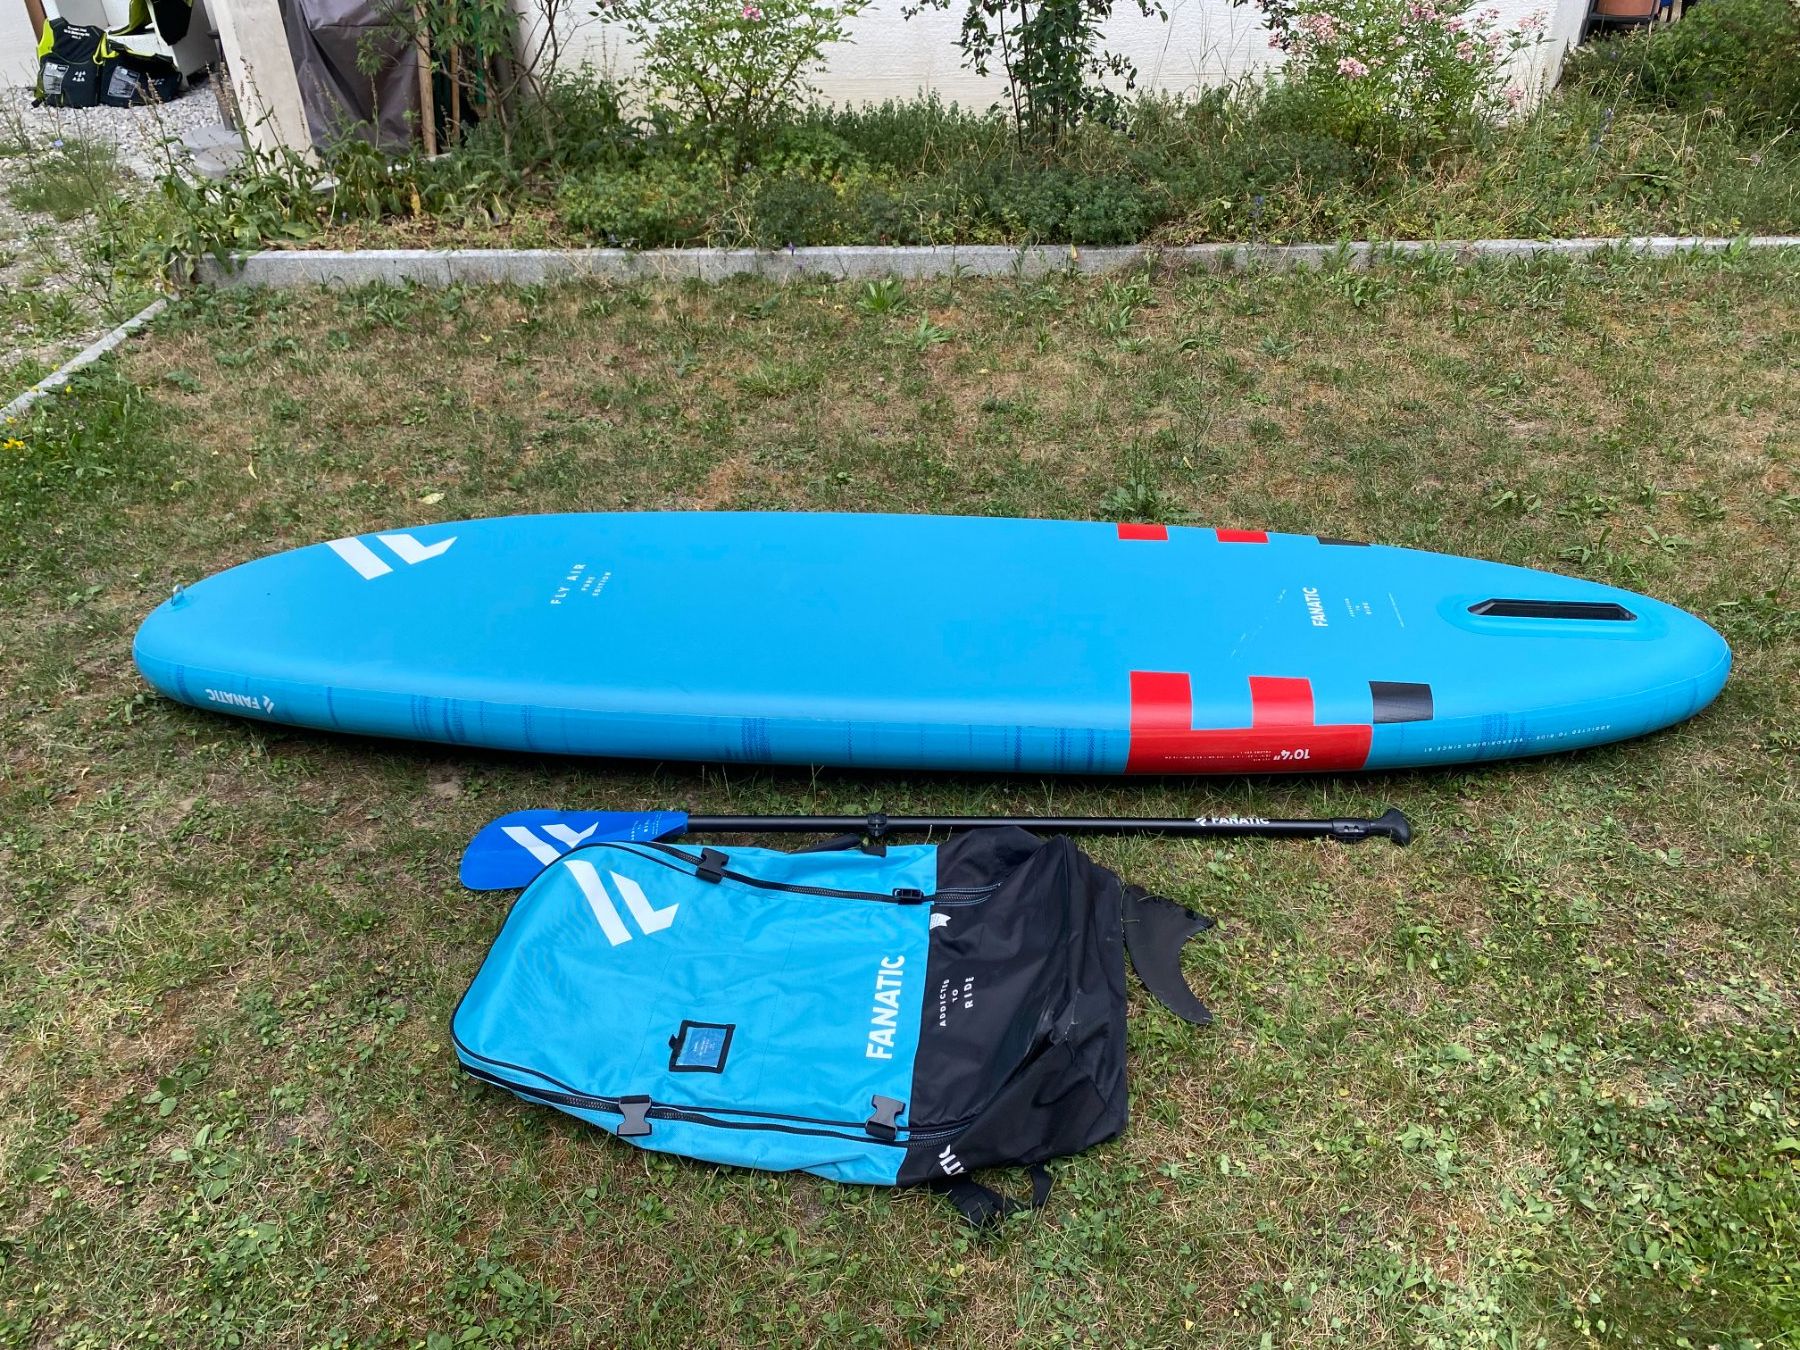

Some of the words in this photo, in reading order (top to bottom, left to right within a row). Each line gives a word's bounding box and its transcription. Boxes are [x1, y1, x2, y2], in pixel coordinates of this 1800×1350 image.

[550, 586, 570, 604] FLY
[566, 564, 586, 581] AIR
[1302, 586, 1328, 627] FANATIC
[205, 688, 261, 709] FANATIC
[1211, 817, 1270, 825] FANATIC
[865, 955, 905, 1060] FANATIC
[939, 979, 950, 1027] ADDICTED
[952, 989, 959, 1003] TO
[964, 976, 975, 1009] RIDE
